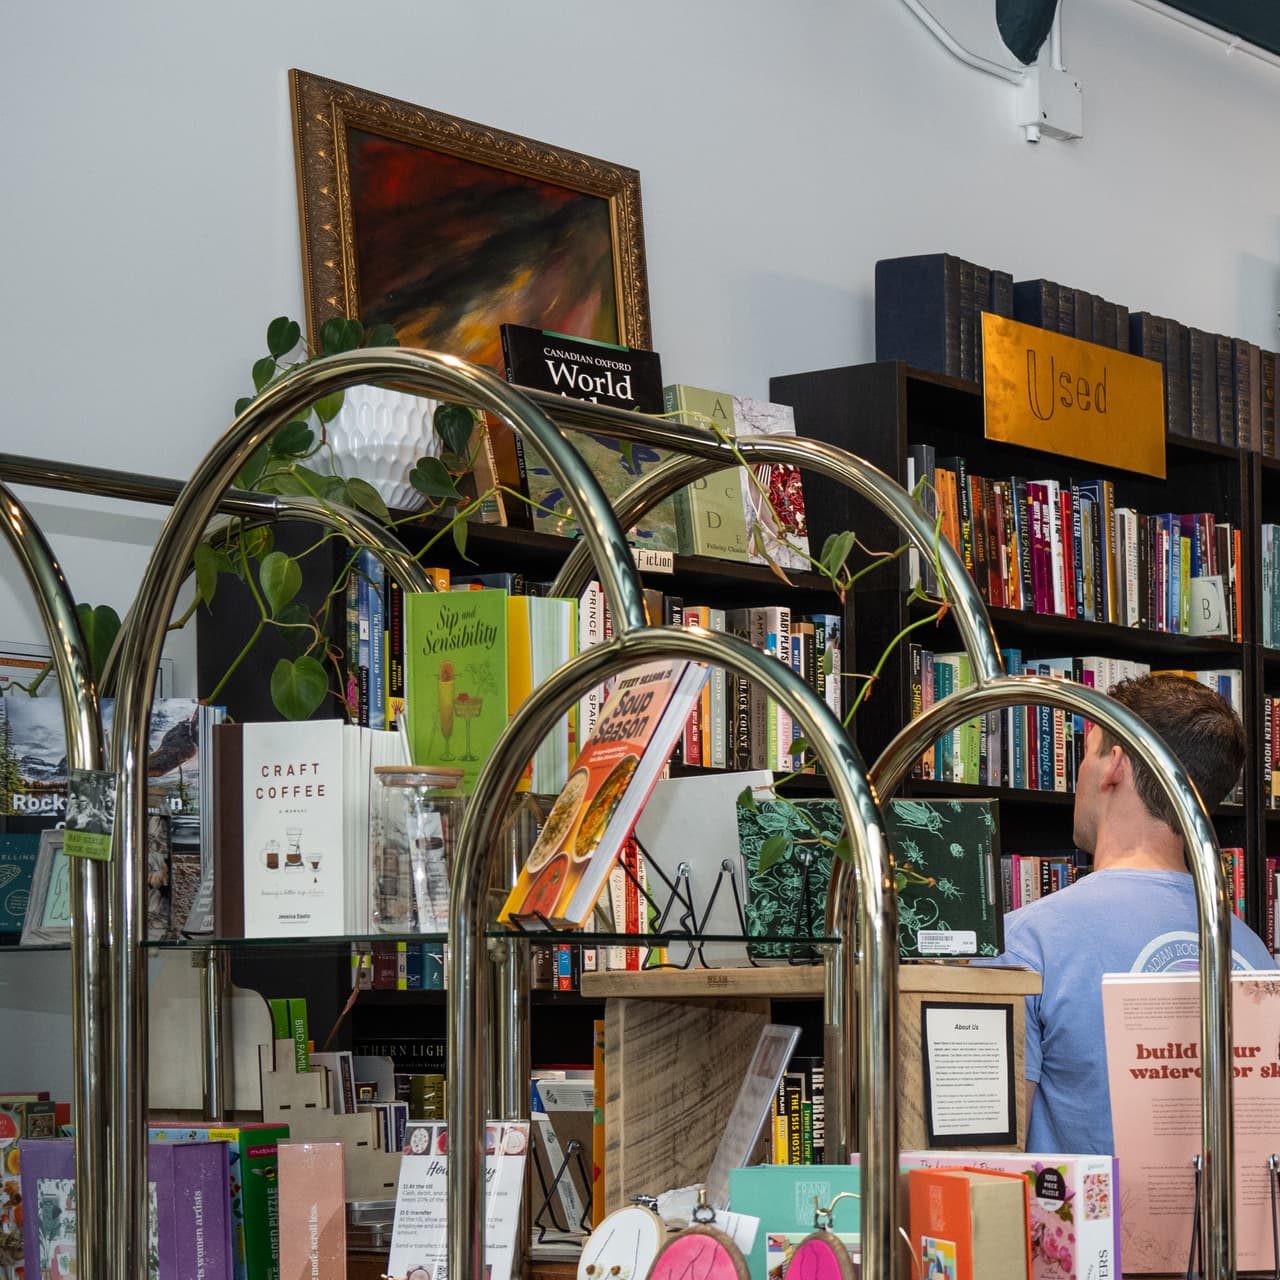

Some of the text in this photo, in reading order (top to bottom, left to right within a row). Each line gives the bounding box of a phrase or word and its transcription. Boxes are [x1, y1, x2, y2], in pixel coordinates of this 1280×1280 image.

[543, 347, 632, 372] CANADIAN OXFORD
[546, 359, 634, 401] World
[1026, 349, 1107, 421] Used
[1072, 486, 1080, 509] STEVE
[436, 604, 477, 631] Sip and
[588, 589, 597, 637] PRINCE
[423, 620, 498, 656] Sensibility
[780, 611, 789, 665] BABY PLAYS
[618, 677, 640, 691] EVERY
[640, 673, 665, 685] SEASON
[613, 690, 654, 719] Soup
[592, 715, 649, 745] Season
[740, 713, 748, 747] COUNT
[1041, 706, 1051, 772] Boat People
[261, 763, 320, 778] CRAFT
[256, 784, 326, 800] COFFEE
[954, 1022, 971, 1031] About
[1136, 1043, 1198, 1060] build
